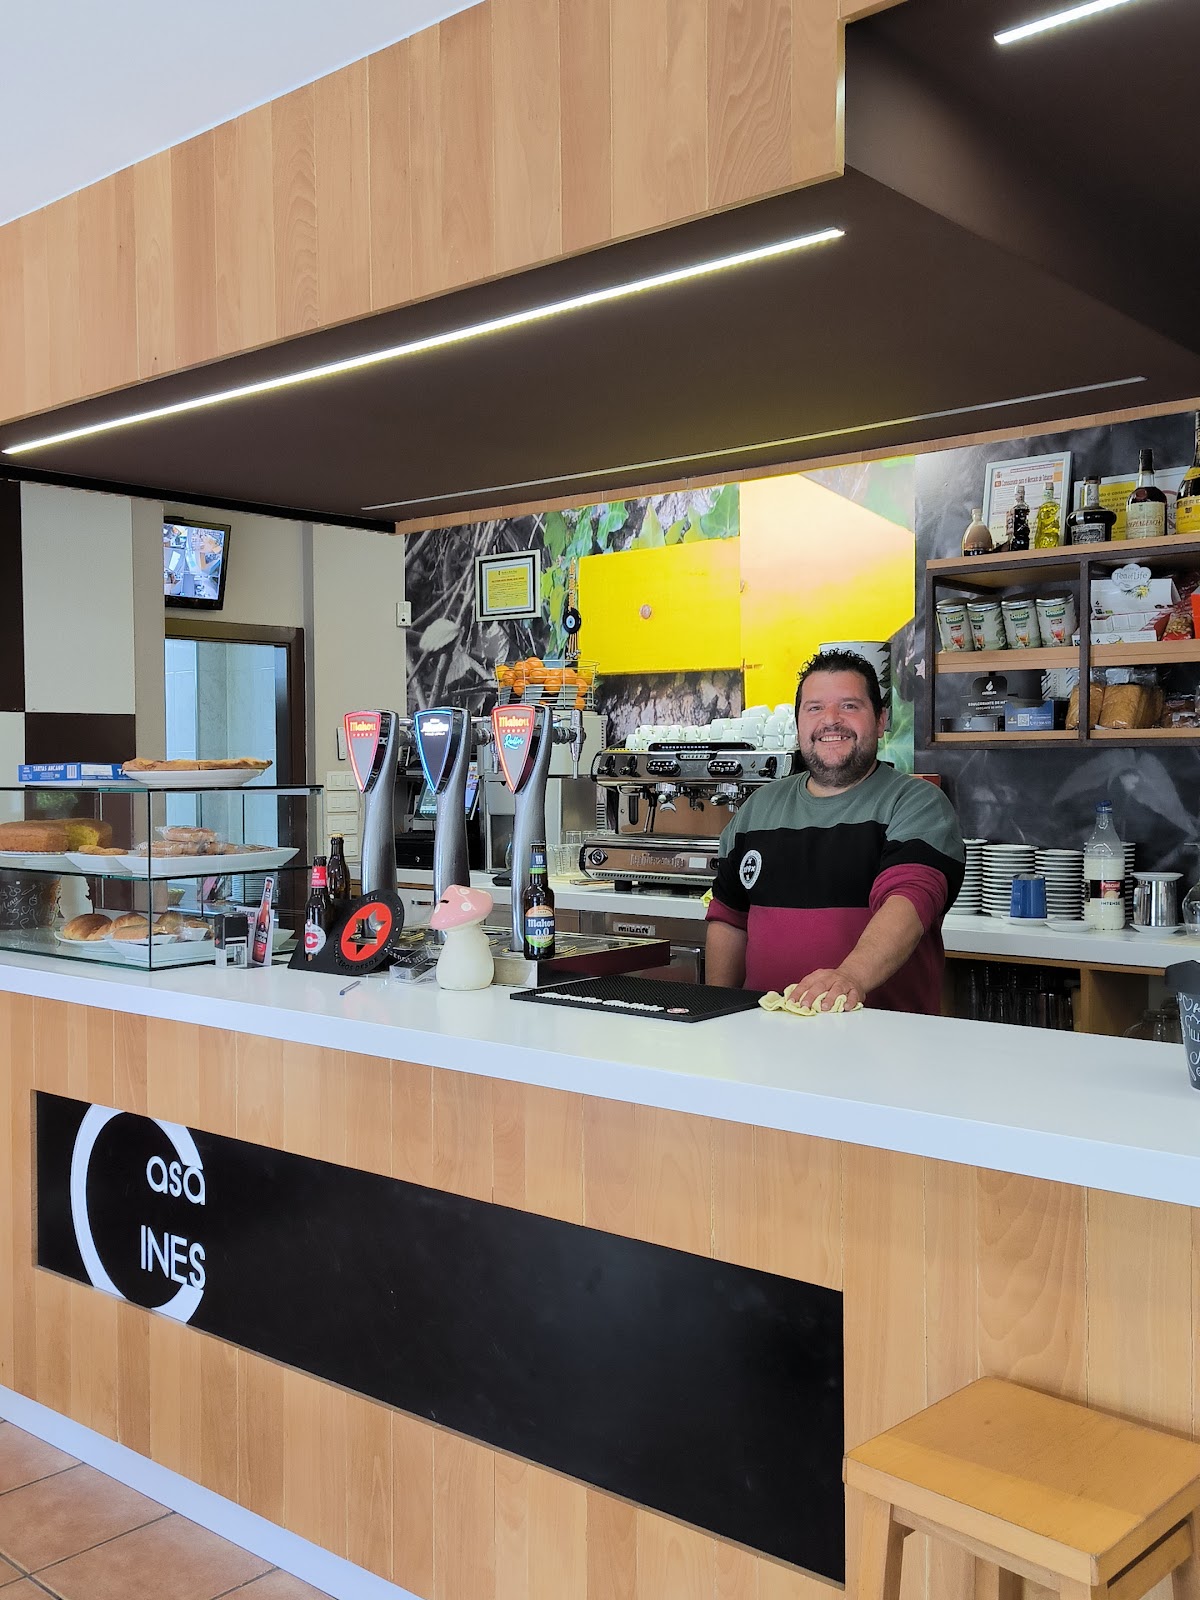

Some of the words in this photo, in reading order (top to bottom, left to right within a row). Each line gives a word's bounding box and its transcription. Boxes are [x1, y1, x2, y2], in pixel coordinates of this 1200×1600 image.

[1115, 572, 1128, 580] Tea
[1134, 570, 1148, 580] Life
[350, 720, 376, 732] Mahou
[499, 715, 529, 728] Mahou
[528, 919, 555, 928] Mahou
[140, 1224, 206, 1291] INES
